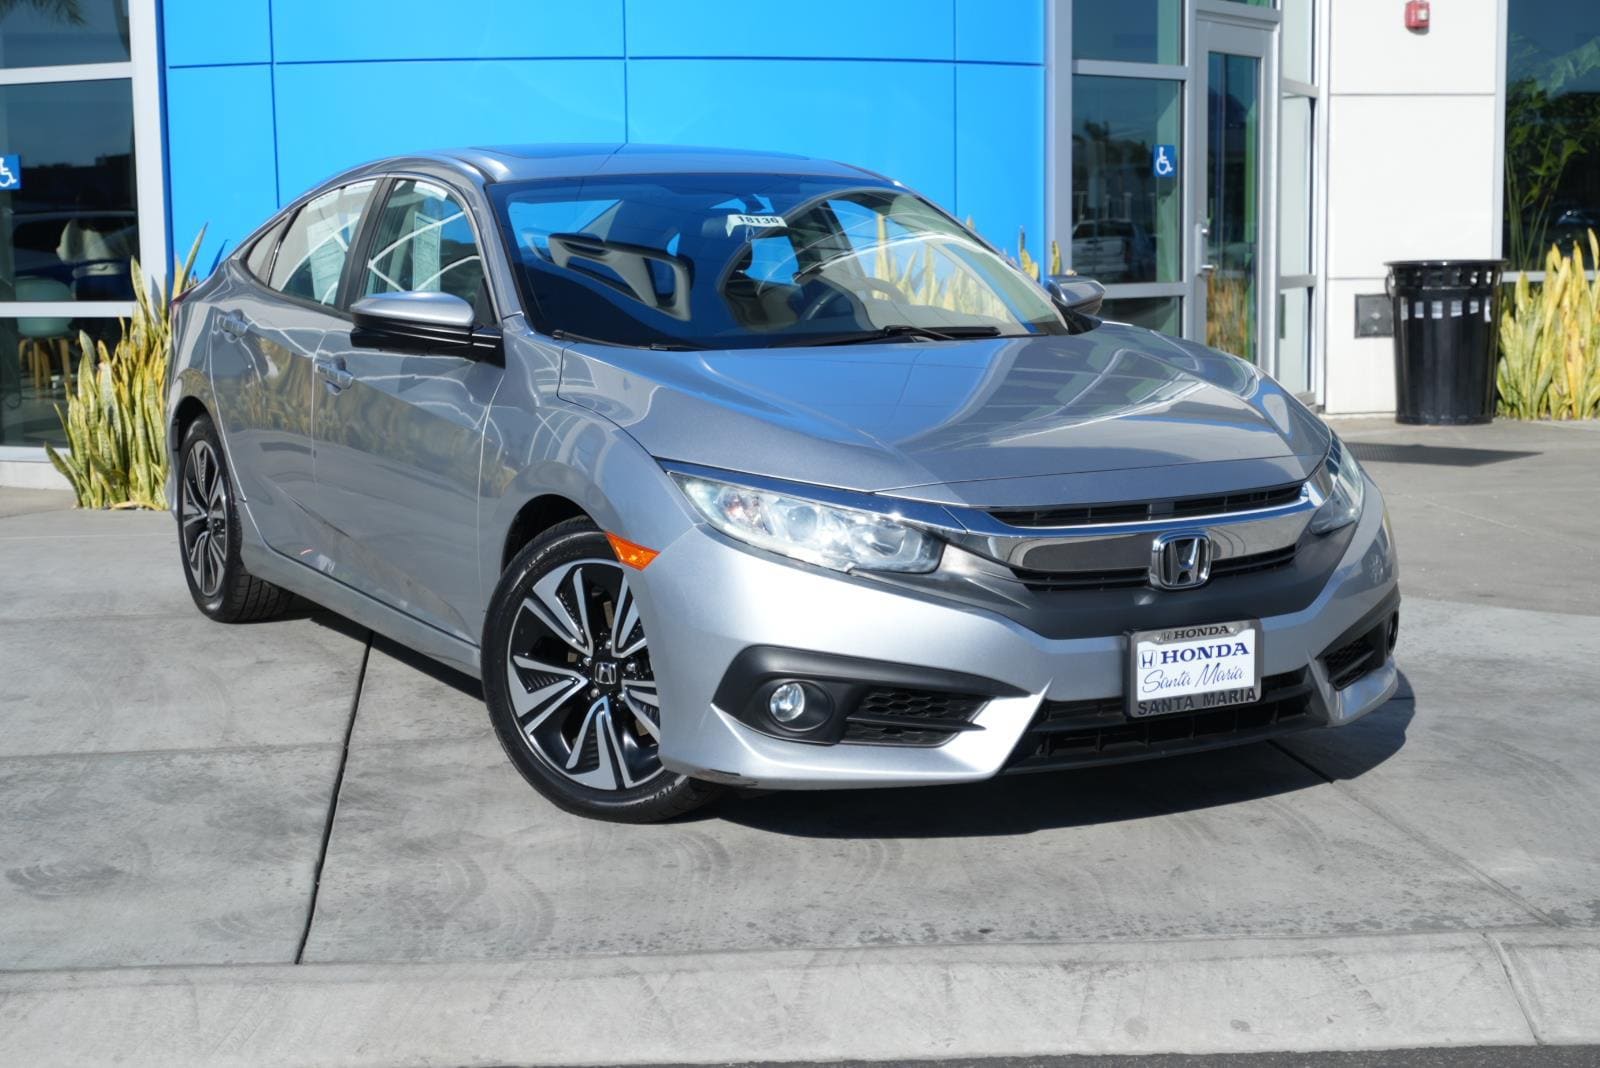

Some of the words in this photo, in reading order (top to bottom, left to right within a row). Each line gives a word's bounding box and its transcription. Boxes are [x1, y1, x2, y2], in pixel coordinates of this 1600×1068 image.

[1174, 625, 1230, 640] HONDA
[1160, 642, 1250, 665] HONDA
[1142, 669, 1191, 693] Santa
[1194, 662, 1244, 688] Maria
[1138, 695, 1195, 716] SANTA
[1203, 687, 1257, 708] MARIA
